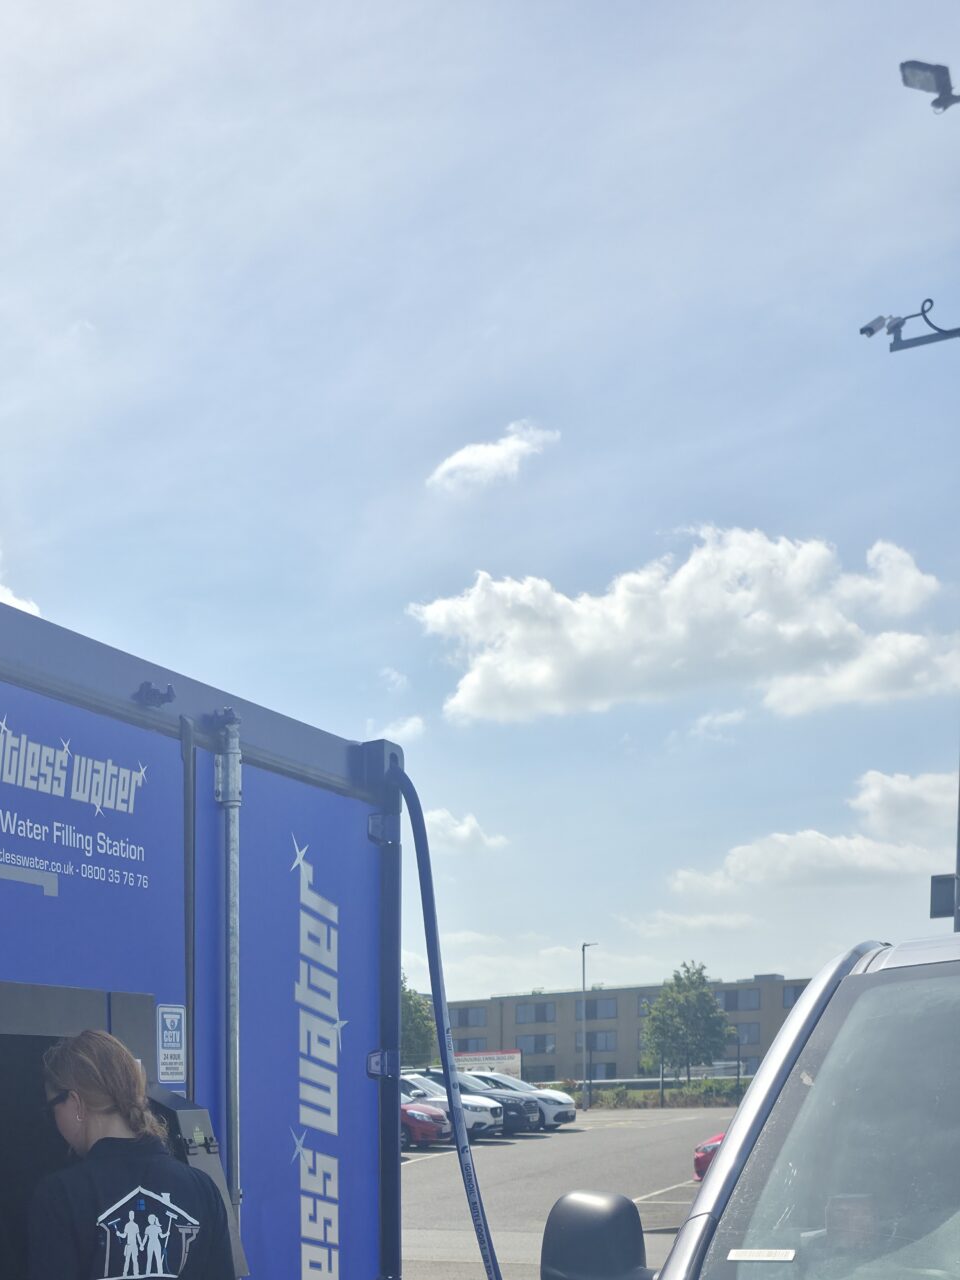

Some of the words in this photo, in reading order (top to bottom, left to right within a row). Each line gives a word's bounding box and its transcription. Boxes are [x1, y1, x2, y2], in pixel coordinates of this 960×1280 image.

[71, 754, 143, 814] water
[53, 821, 93, 856] Filling
[96, 832, 145, 862] Station
[80, 864, 106, 881] 0800
[108, 868, 121, 884] 35
[122, 871, 135, 887] 76
[136, 874, 149, 889] 76
[294, 858, 339, 1137] water
[163, 1030, 180, 1043] CCTV
